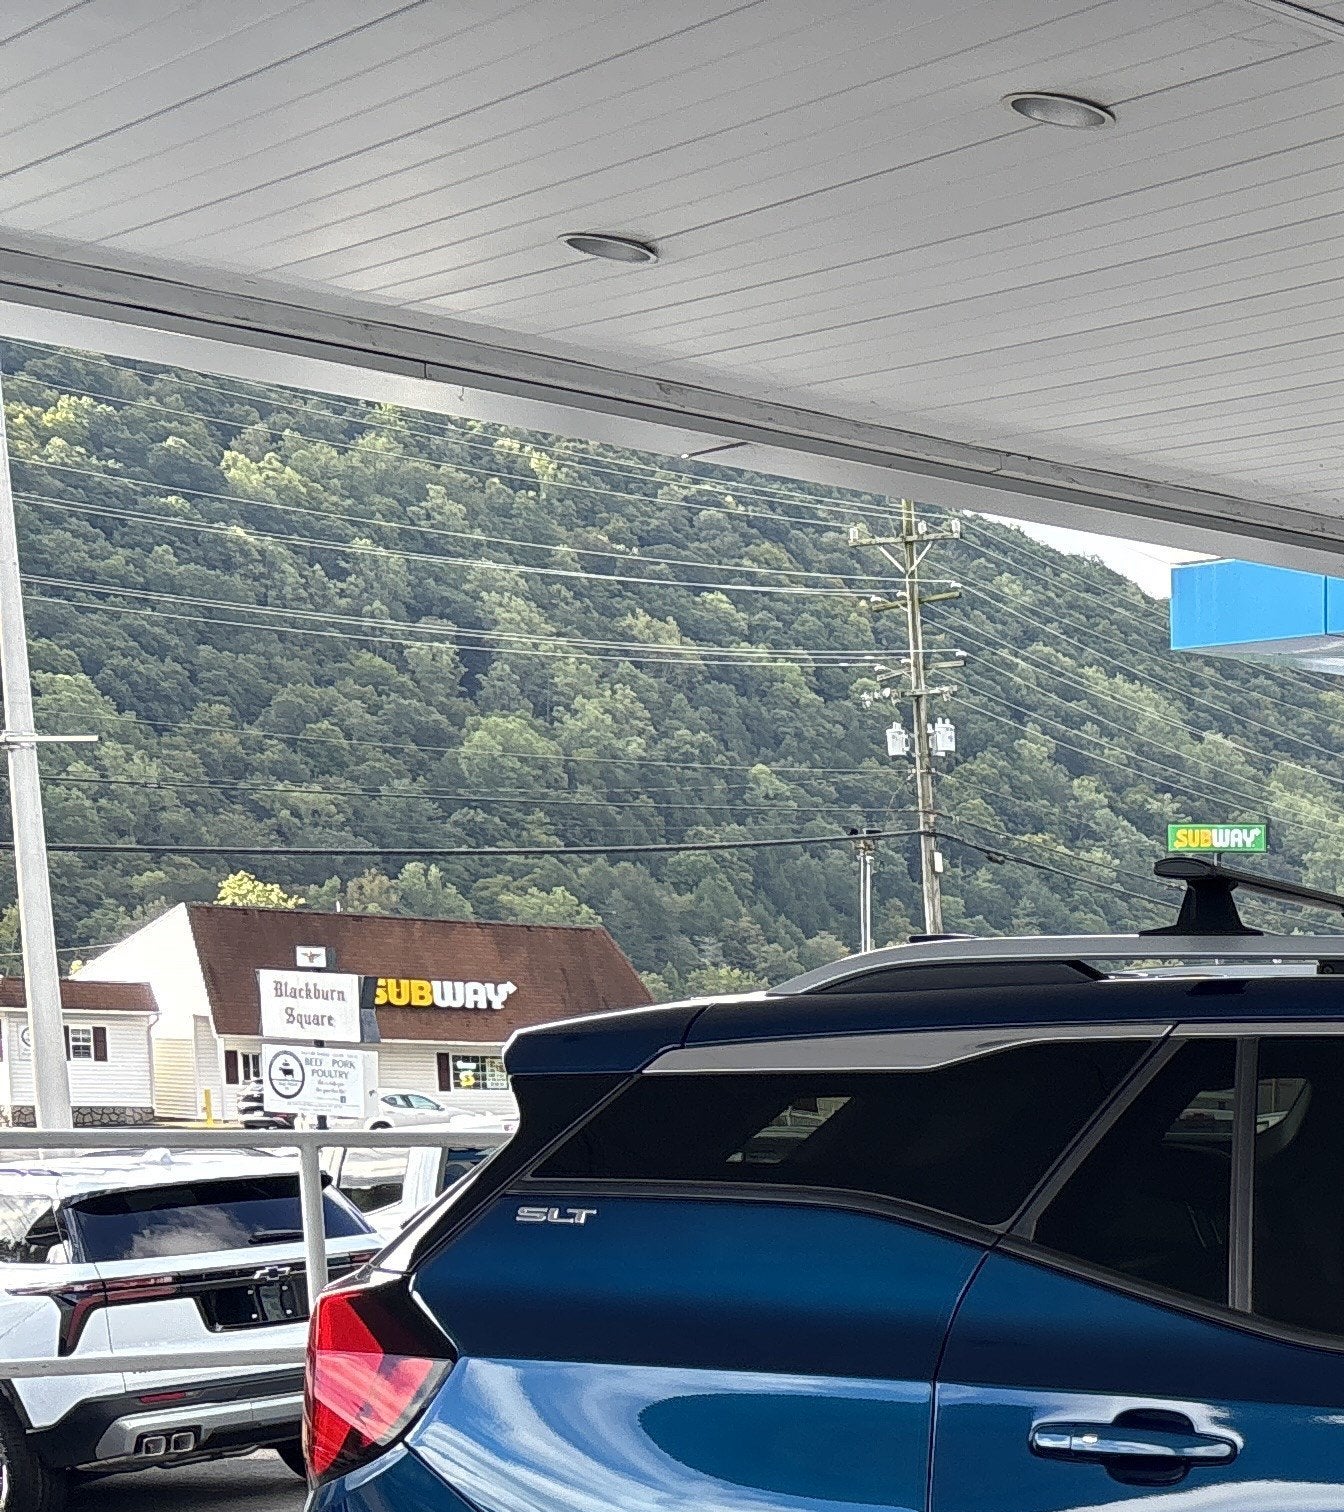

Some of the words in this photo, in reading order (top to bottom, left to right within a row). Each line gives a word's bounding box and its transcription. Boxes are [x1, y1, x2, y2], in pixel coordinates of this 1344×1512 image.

[1173, 828, 1262, 848] SUBWAY
[273, 980, 346, 1002] Blackburn
[375, 978, 518, 1010] SUBWAY
[284, 1006, 336, 1029] Square
[331, 1058, 356, 1069] PORK
[311, 1068, 350, 1080] POULTRY
[515, 1206, 598, 1224] SLT
